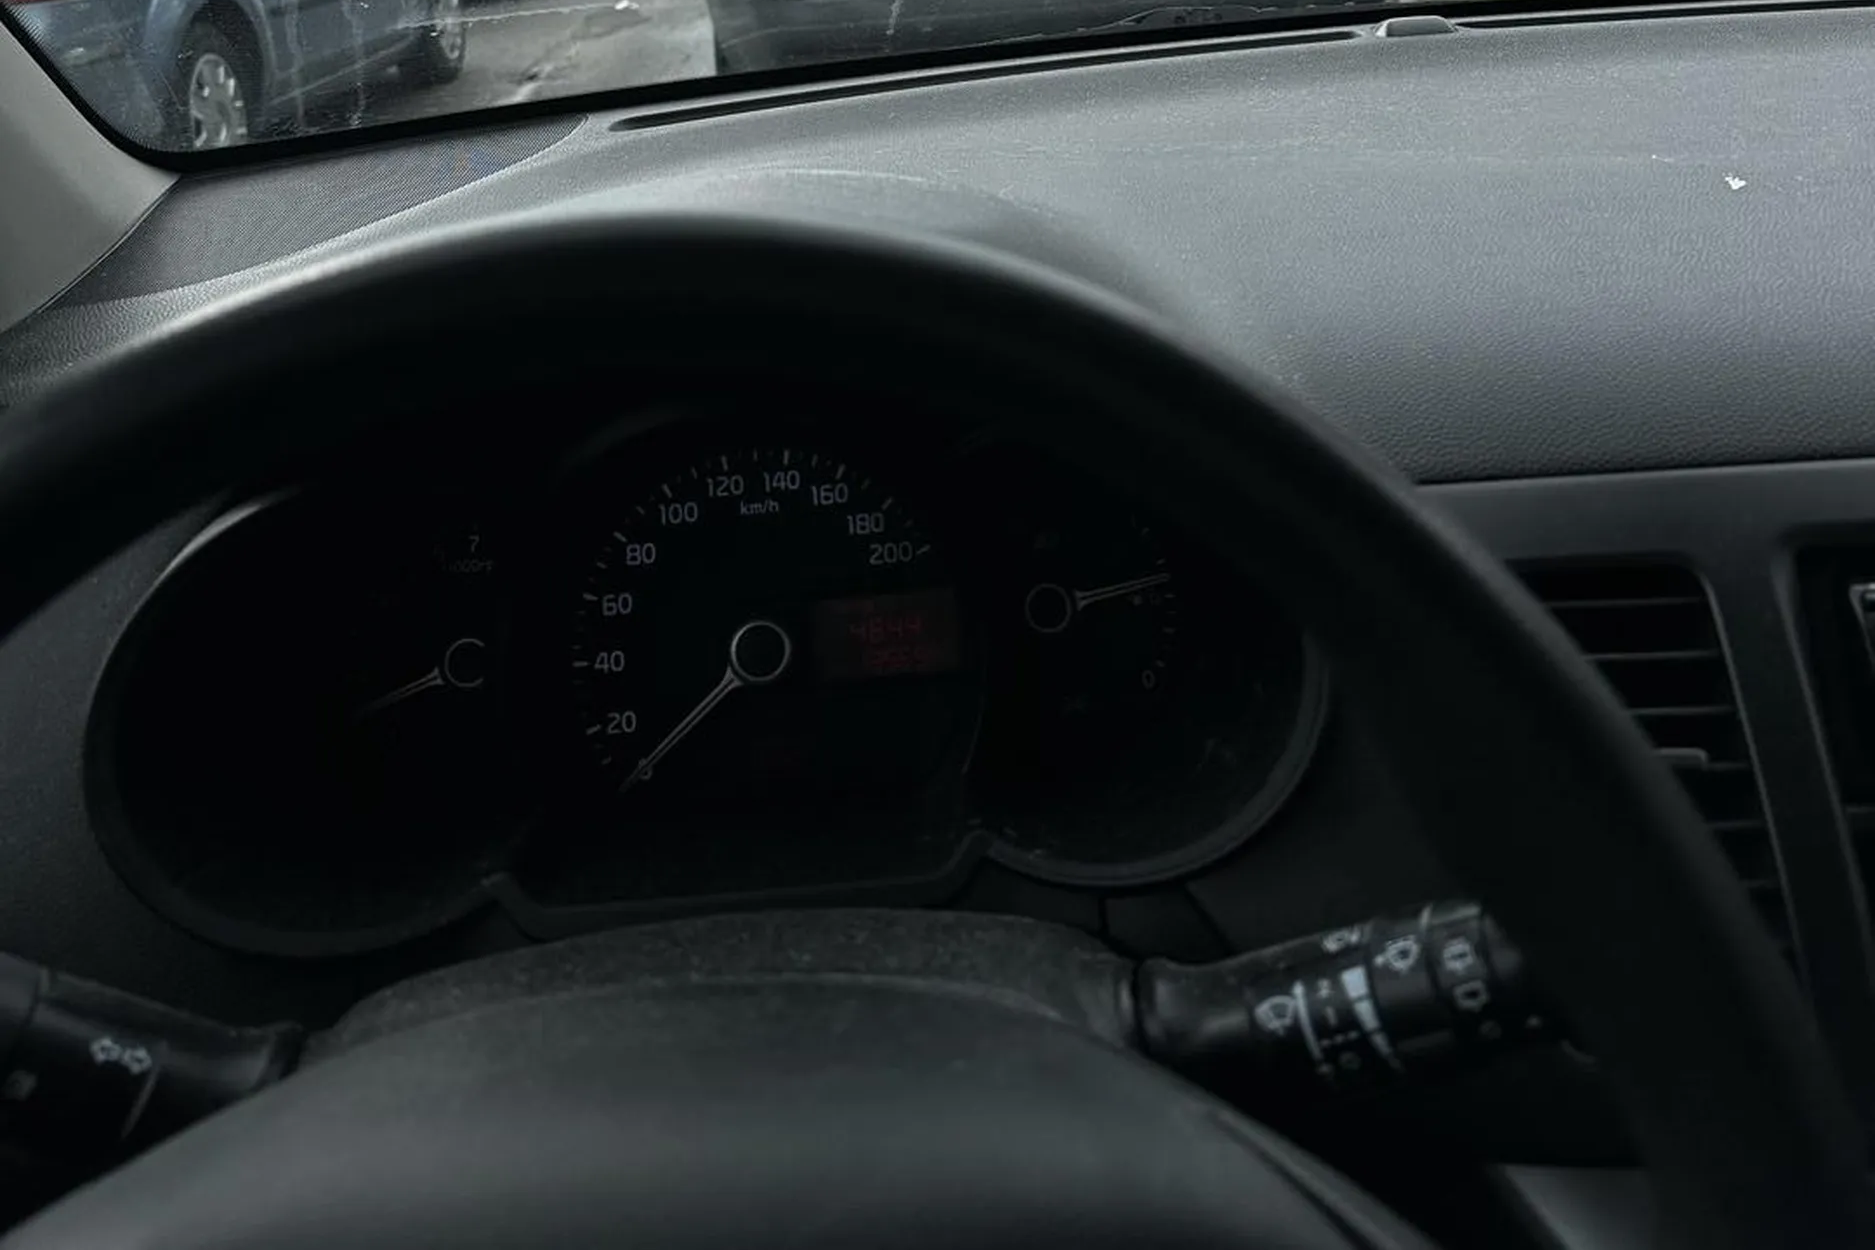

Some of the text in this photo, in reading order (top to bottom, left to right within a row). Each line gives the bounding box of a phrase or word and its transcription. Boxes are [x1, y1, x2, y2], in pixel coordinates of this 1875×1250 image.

[707, 476, 744, 497] 120
[763, 471, 801, 491] 140
[811, 483, 849, 505] 160
[659, 502, 699, 525] 100
[740, 499, 780, 515] km/h
[848, 513, 885, 535] 180
[625, 543, 657, 566] 80
[869, 541, 914, 565] 200
[602, 593, 633, 616] 60
[594, 651, 626, 672] 40
[607, 711, 637, 735] 20
